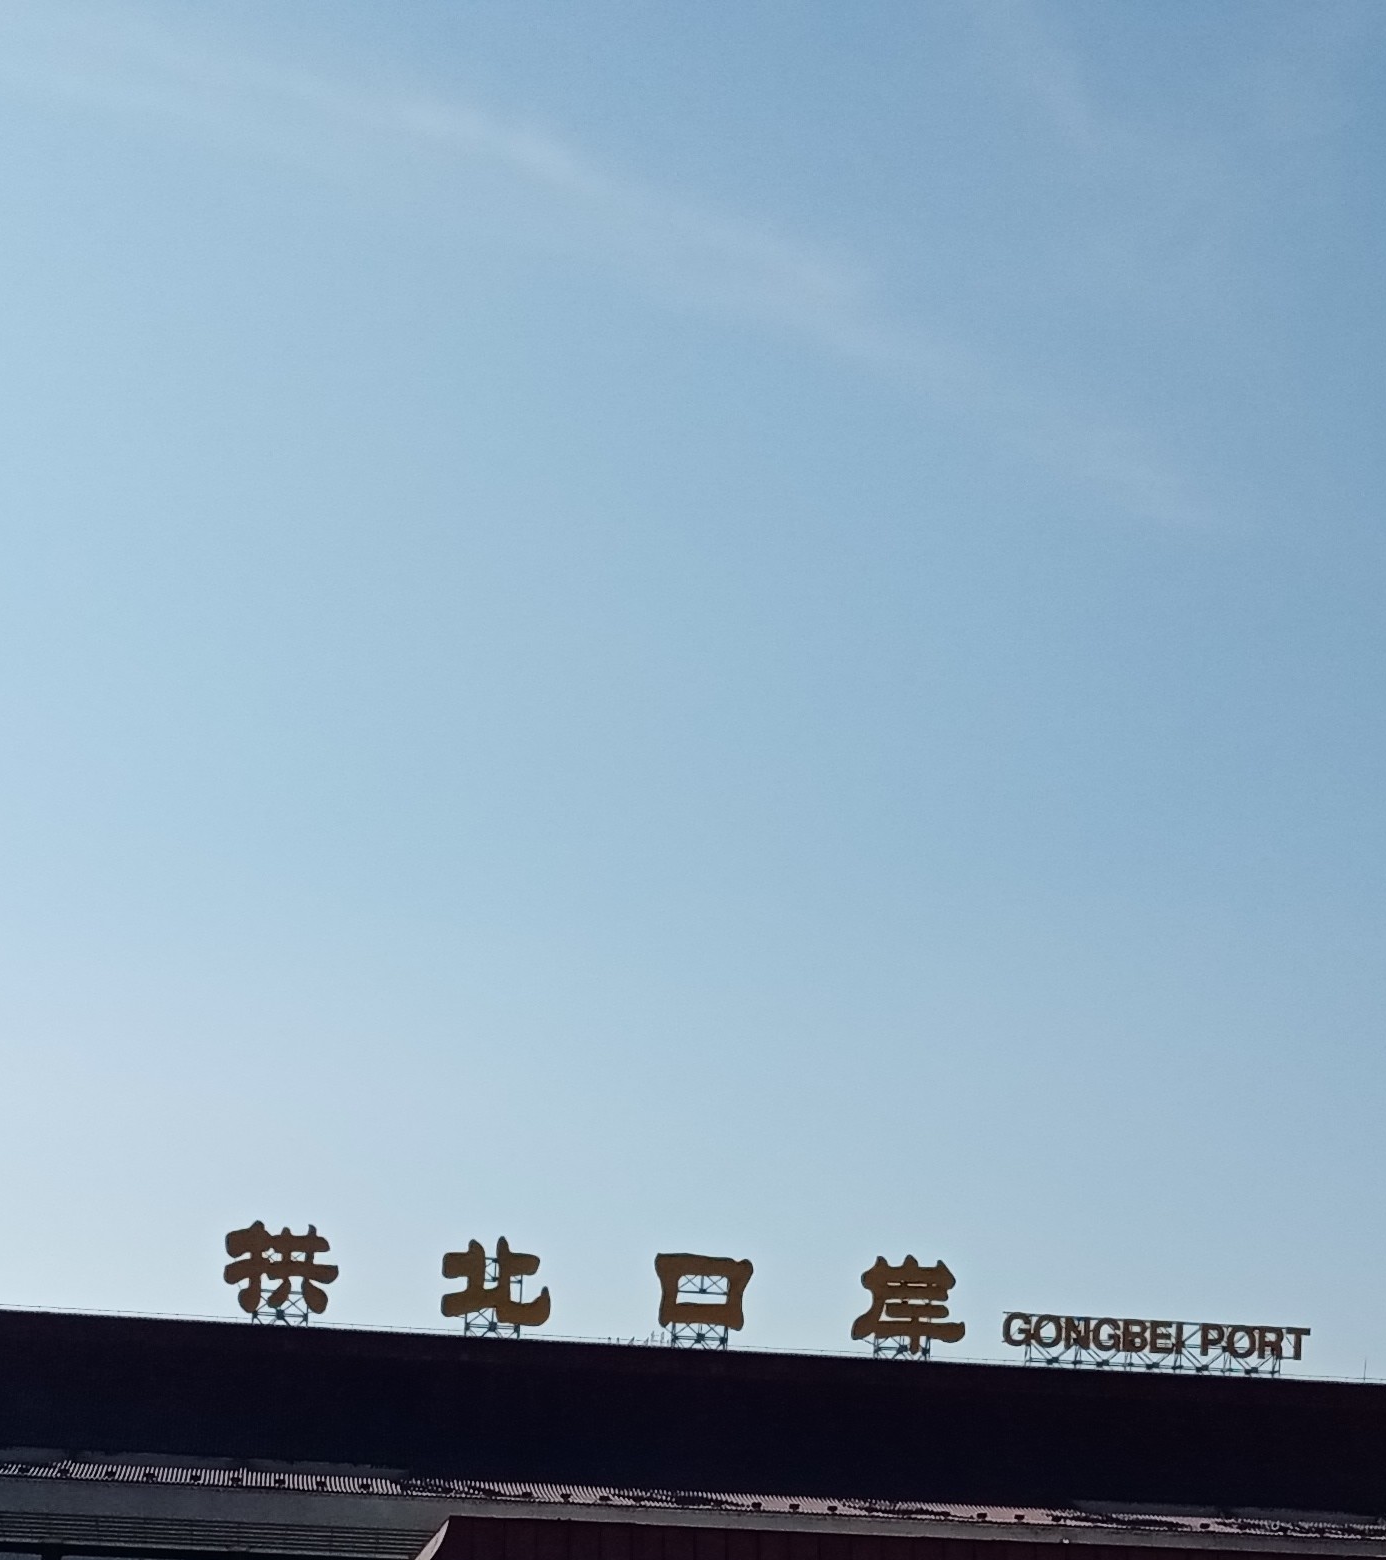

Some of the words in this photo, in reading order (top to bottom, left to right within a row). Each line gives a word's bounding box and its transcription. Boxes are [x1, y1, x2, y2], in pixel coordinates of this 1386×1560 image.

[224, 1220, 966, 1354] 拱北口岸
[1002, 1312, 1184, 1354] GONGBEI
[1200, 1323, 1311, 1361] PORT
